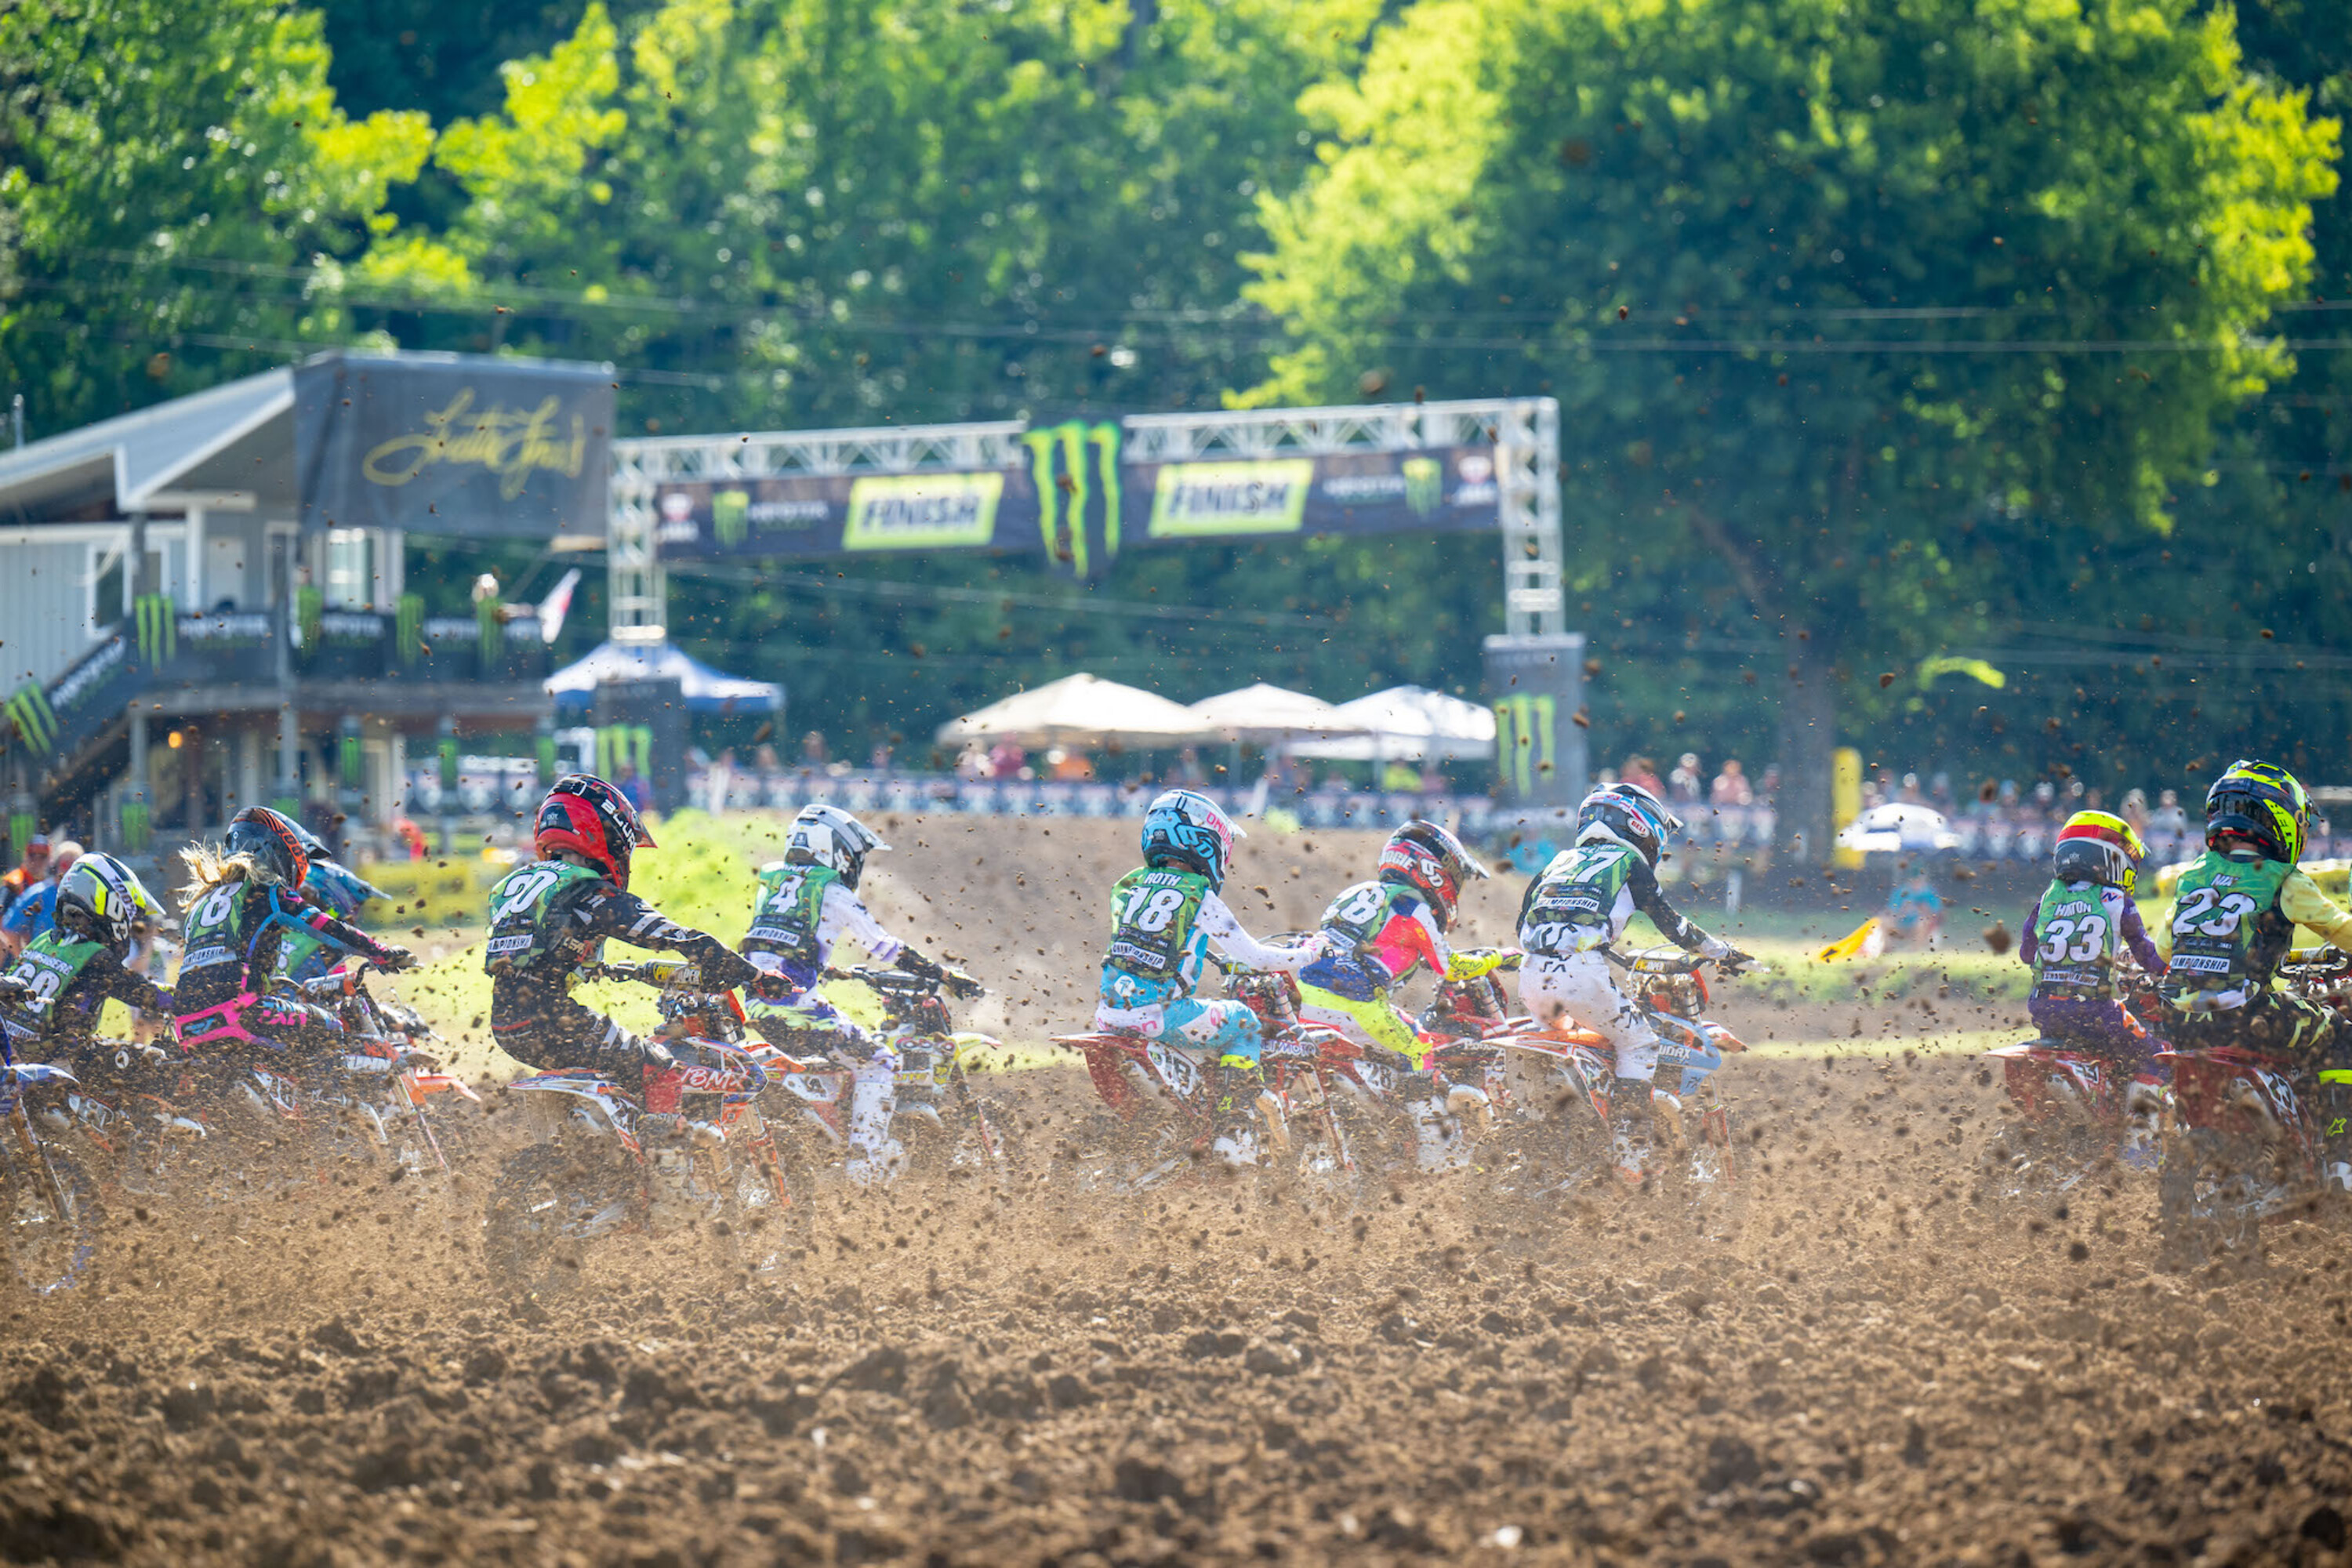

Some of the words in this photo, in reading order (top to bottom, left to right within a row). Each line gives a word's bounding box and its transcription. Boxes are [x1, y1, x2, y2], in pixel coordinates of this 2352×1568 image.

[862, 495, 980, 533] FINISH
[1168, 481, 1289, 518] FINISH
[1143, 872, 1183, 887] ROTH
[1541, 848, 1629, 884] 27
[768, 874, 807, 913] 4
[1121, 886, 1185, 933] 18
[2172, 887, 2257, 936] 23
[1112, 942, 1164, 967] CHAMPIONSHIP
[2039, 914, 2107, 963] 33
